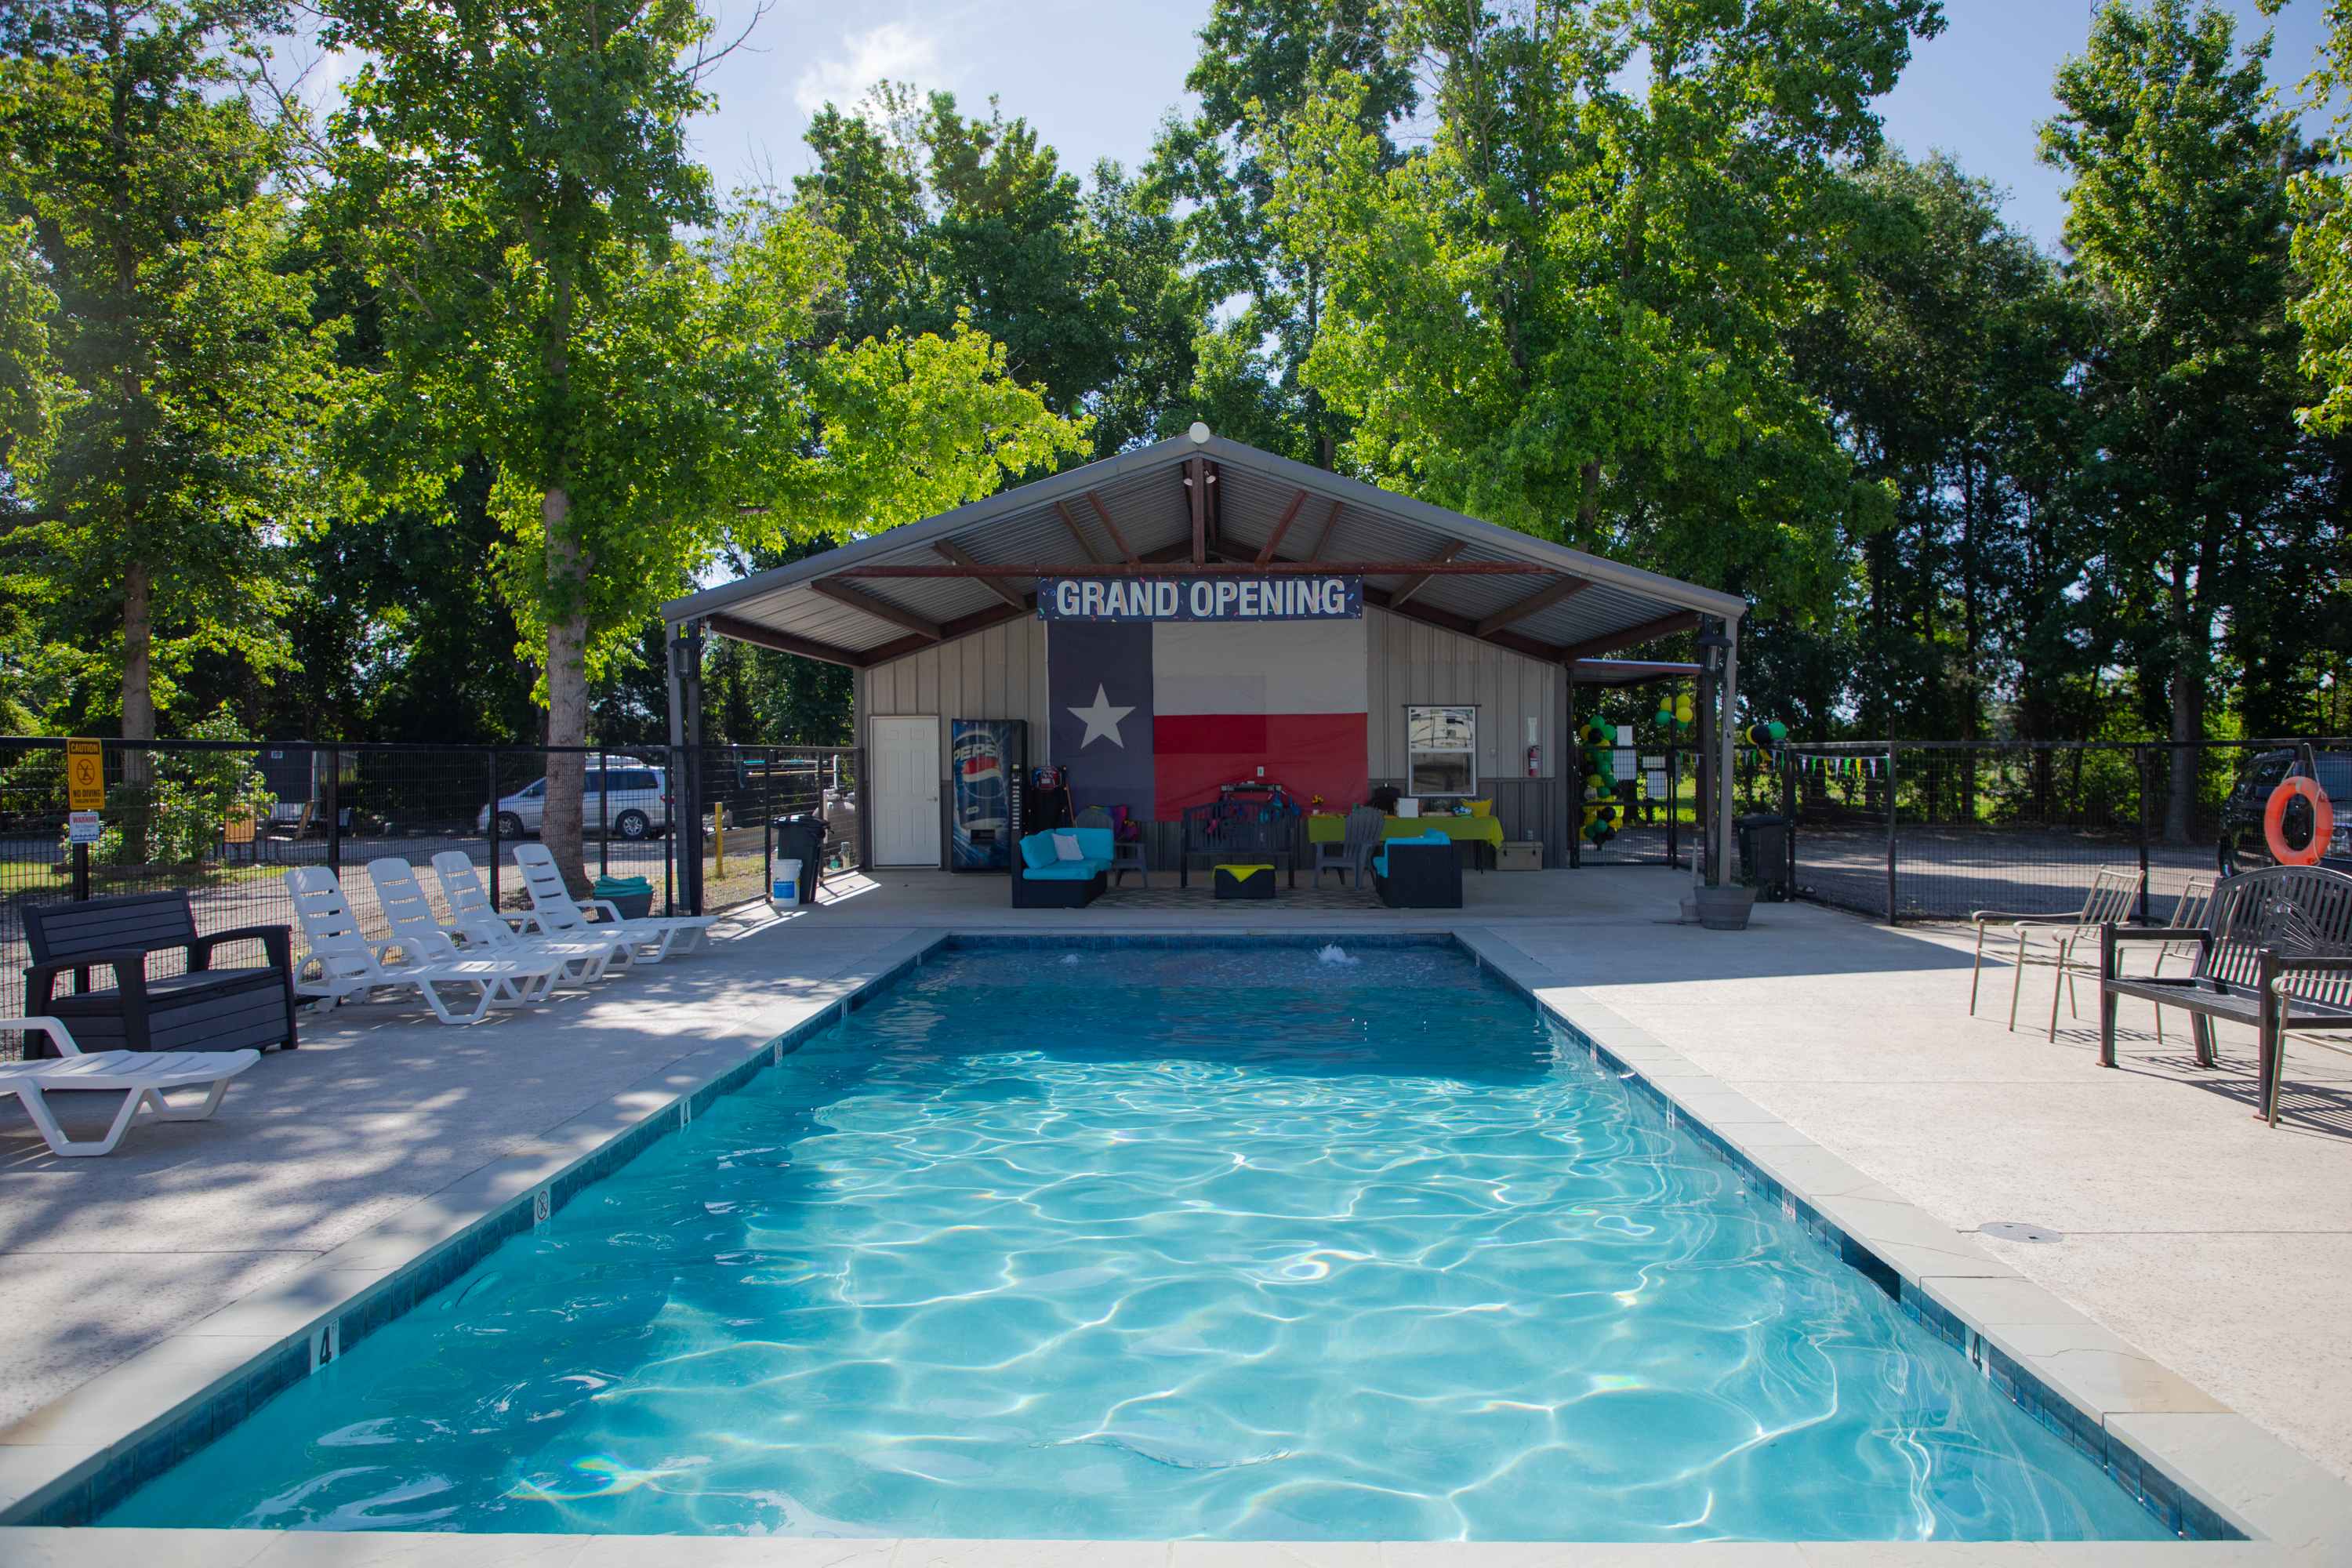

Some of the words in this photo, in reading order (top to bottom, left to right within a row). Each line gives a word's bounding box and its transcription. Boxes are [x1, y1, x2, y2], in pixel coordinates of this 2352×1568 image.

[1057, 581, 1178, 616] GRAND
[1190, 579, 1345, 616] OPENING
[71, 743, 99, 753] CAUTION
[82, 789, 101, 797] DIVING
[320, 1324, 332, 1366] 4
[1973, 1332, 1983, 1374] 4
